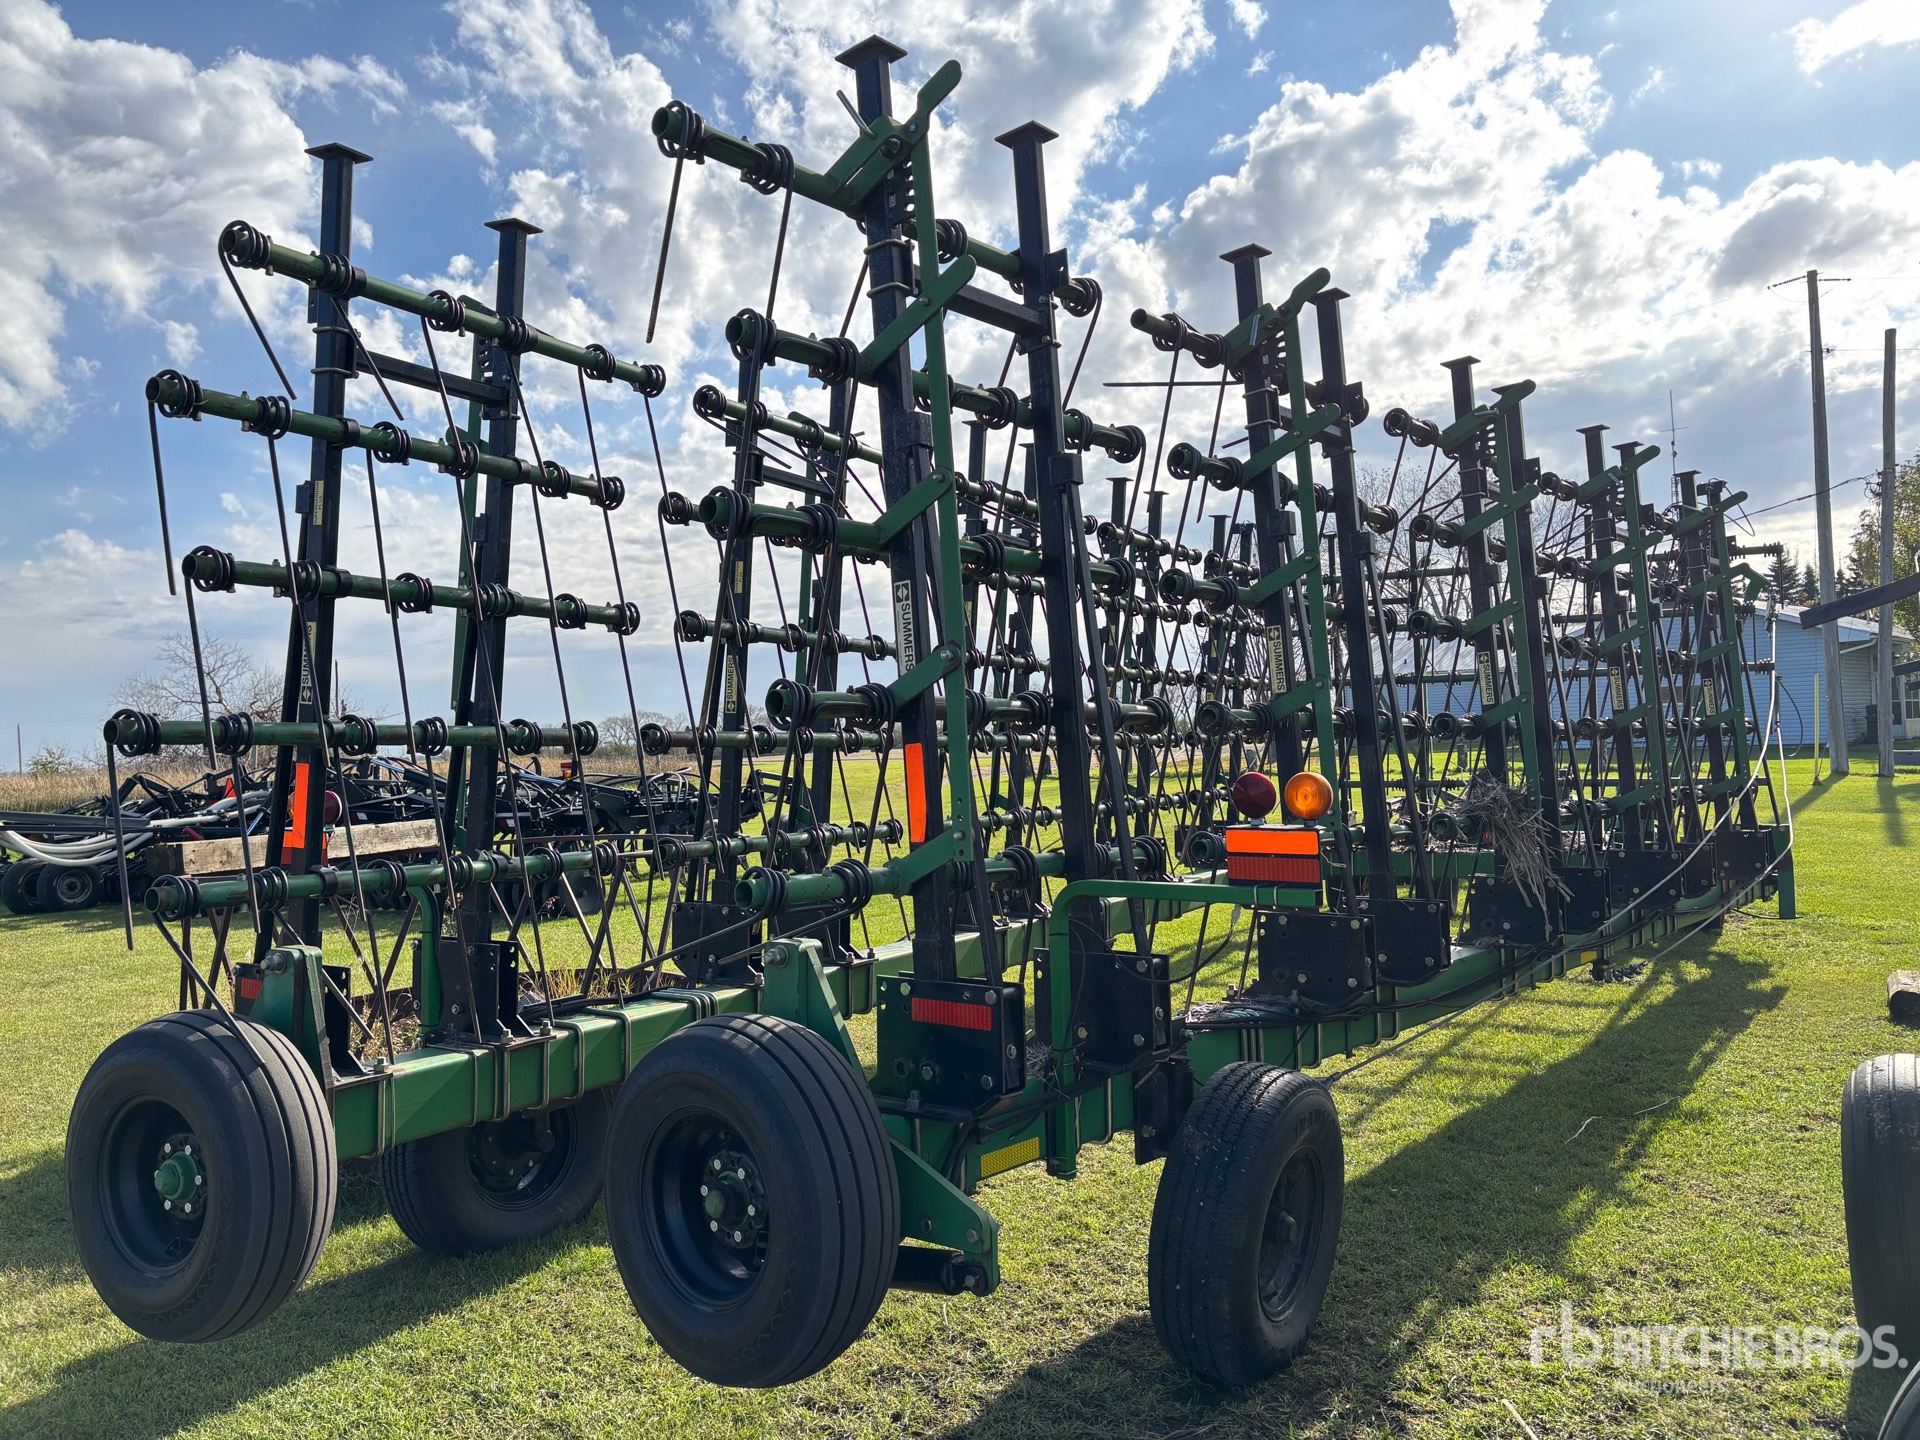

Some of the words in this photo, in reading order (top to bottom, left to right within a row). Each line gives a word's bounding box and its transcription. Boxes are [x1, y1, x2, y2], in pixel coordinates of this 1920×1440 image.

[302, 624, 313, 685] SUMS
[901, 602, 915, 672] SUMMERS
[727, 657, 735, 700] SUMMERS
[1273, 641, 1285, 691] SUMMERS
[1483, 663, 1494, 703] SUMMERS
[1613, 676, 1624, 709] SUMMERS
